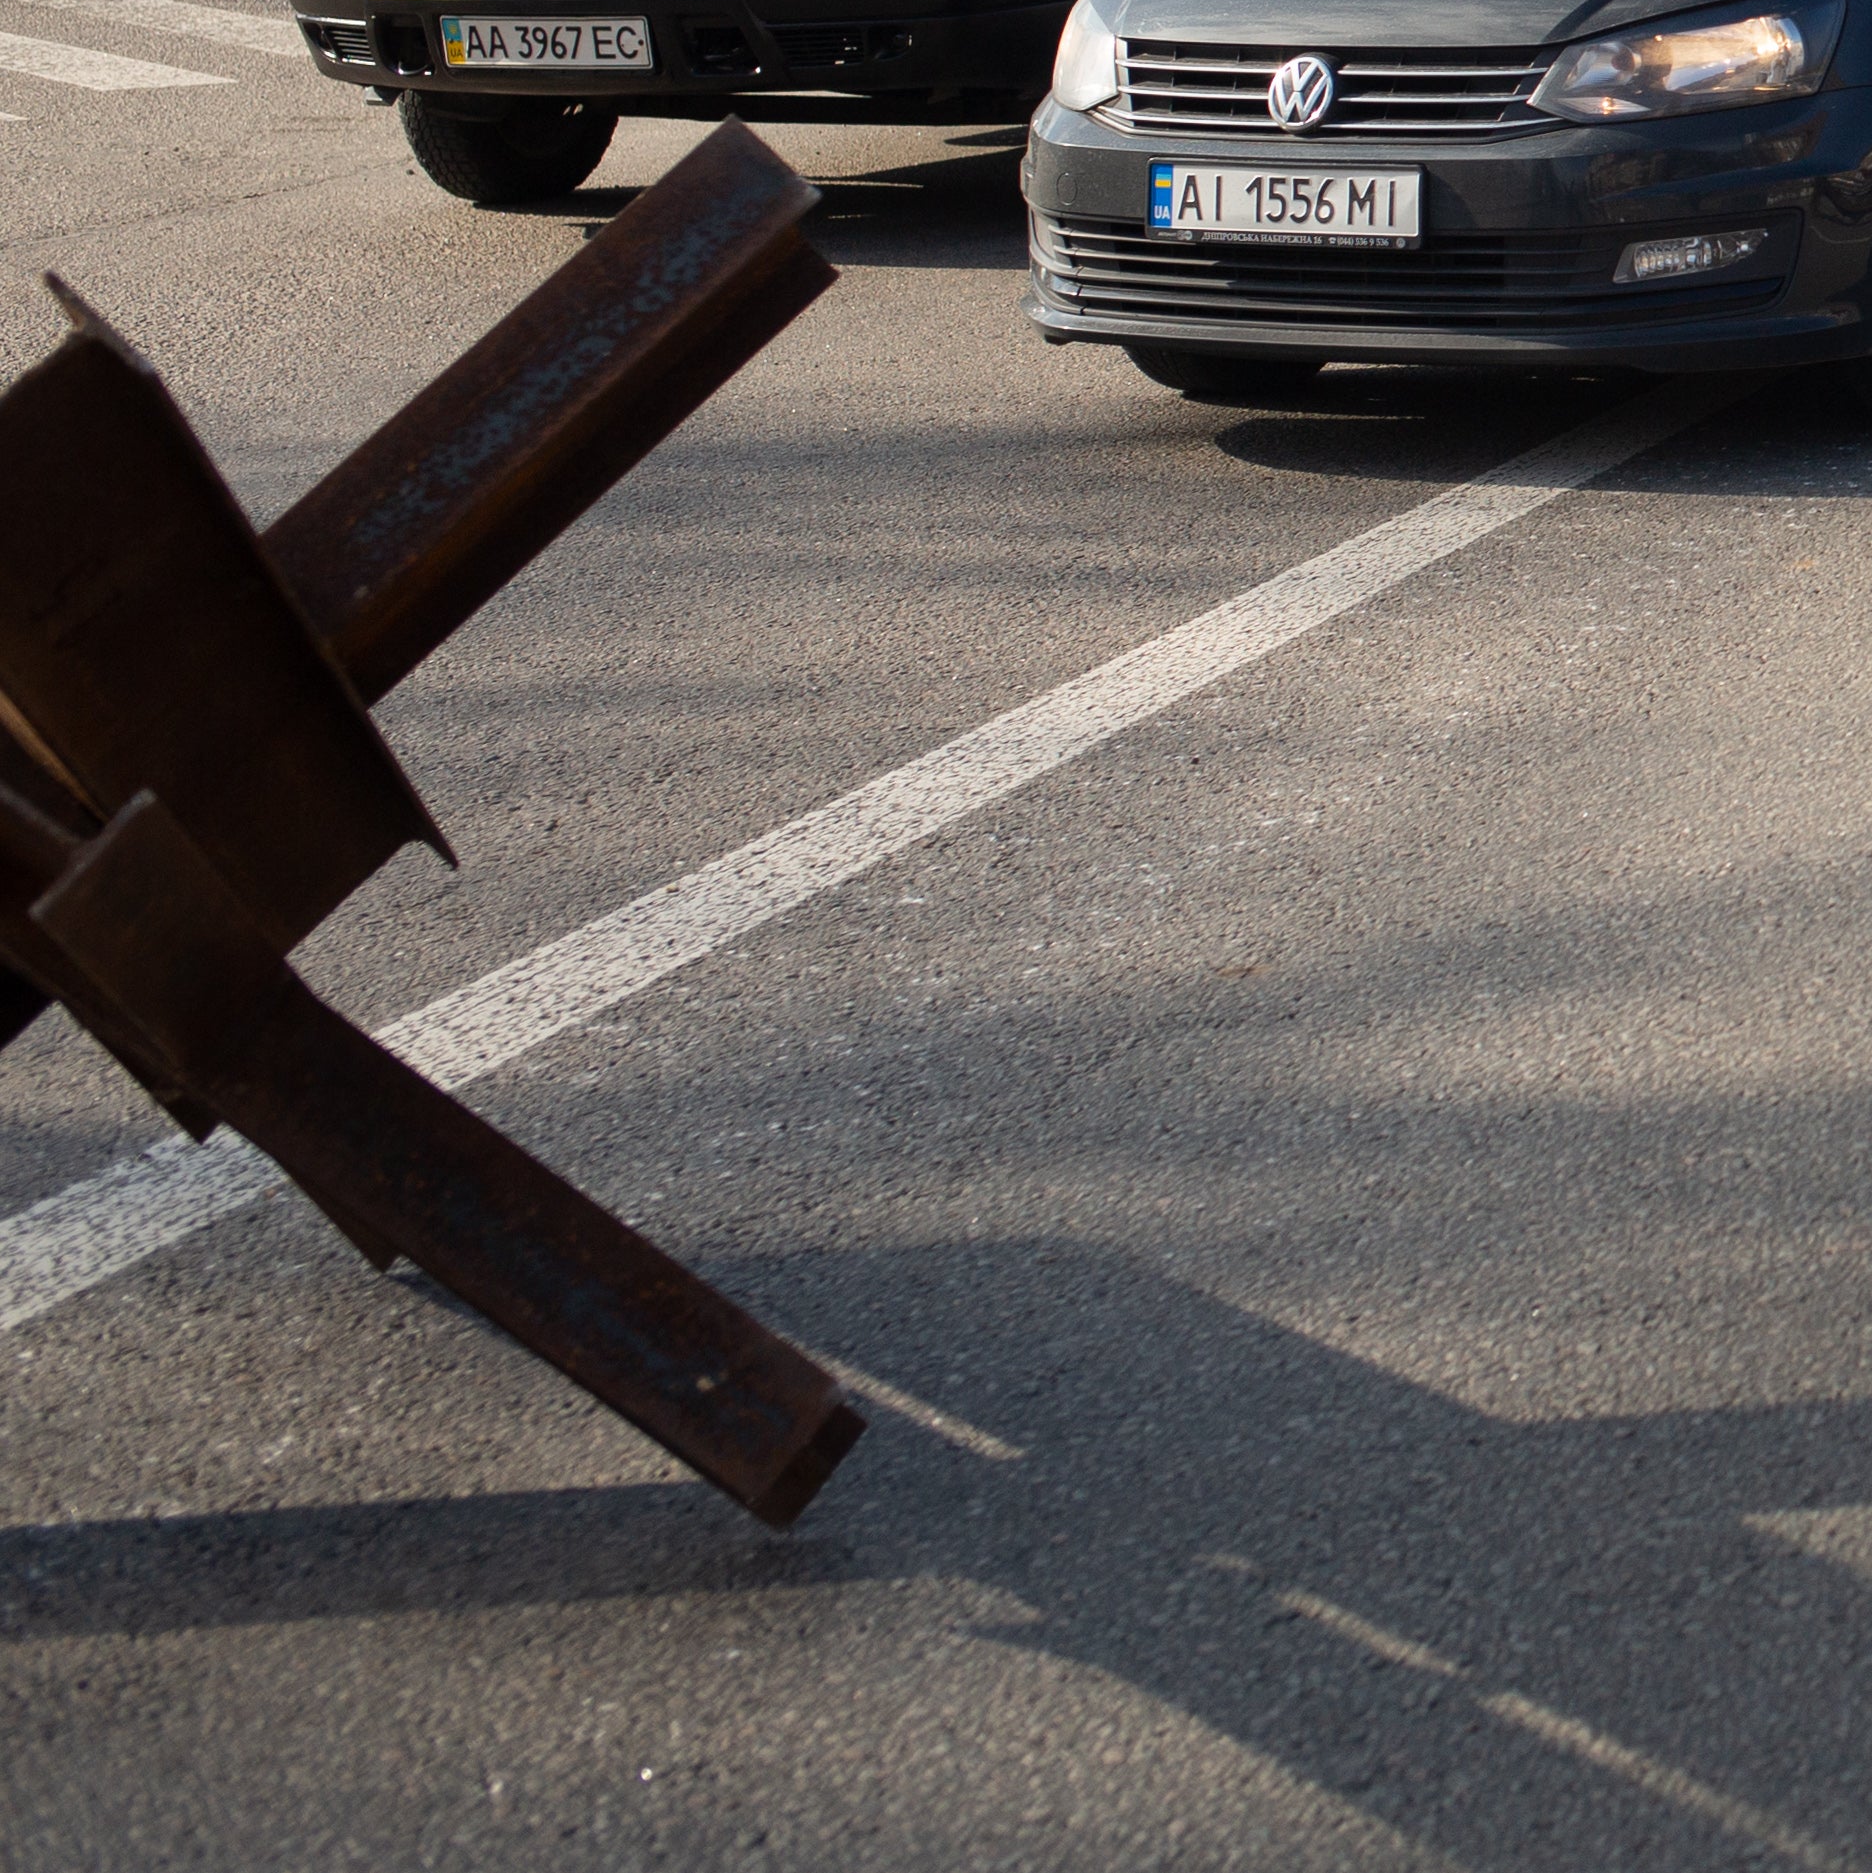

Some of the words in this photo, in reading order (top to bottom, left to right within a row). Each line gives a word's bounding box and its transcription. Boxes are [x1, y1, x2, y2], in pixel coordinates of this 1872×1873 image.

[450, 49, 464, 59] UA
[467, 26, 509, 59] AA
[514, 26, 582, 59] 3967
[592, 26, 638, 59] EC
[1177, 175, 1222, 221] AI
[1245, 176, 1335, 225] 1556
[1347, 178, 1396, 226] MI
[1154, 206, 1171, 220] UA
